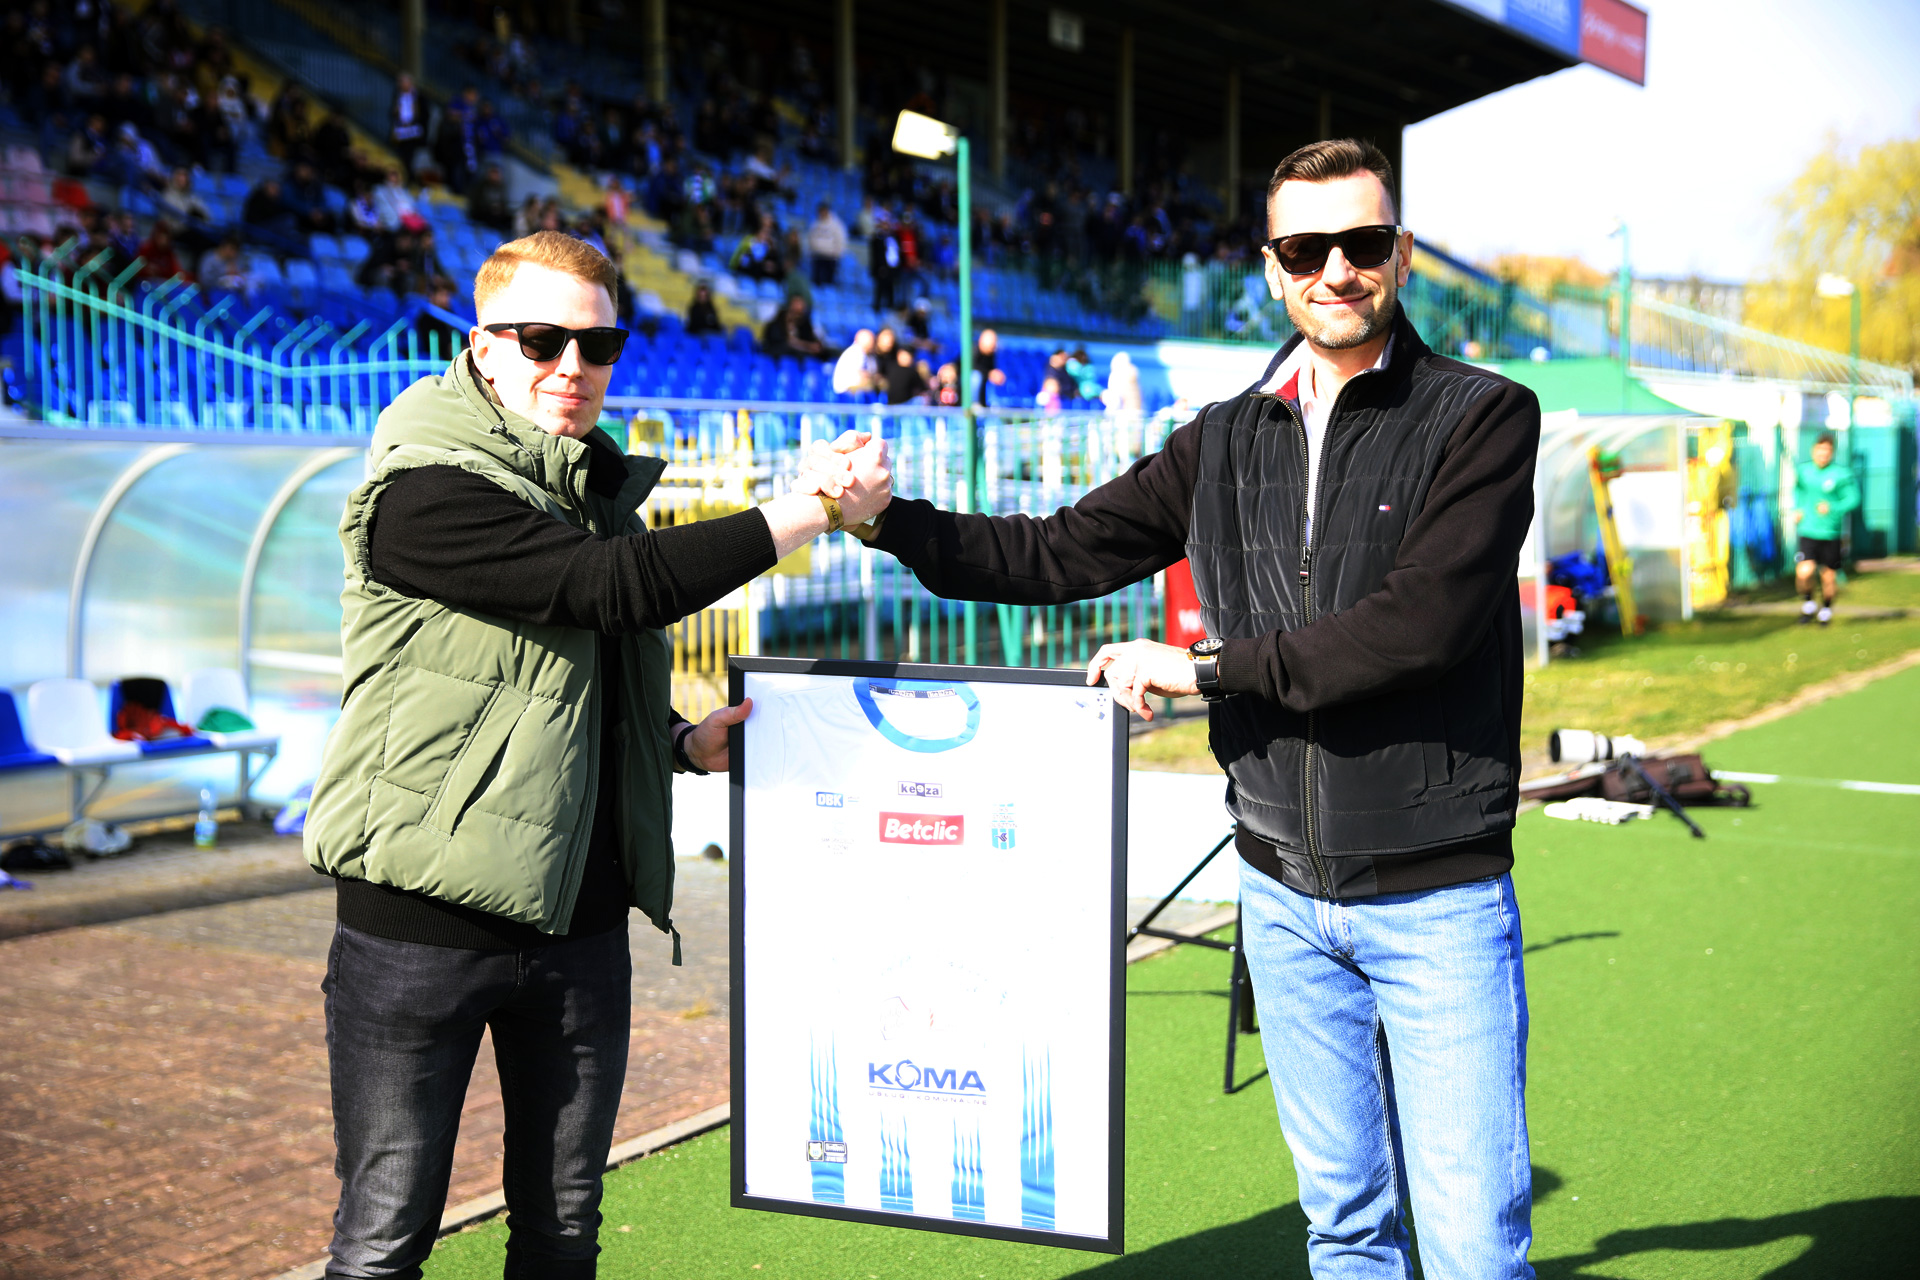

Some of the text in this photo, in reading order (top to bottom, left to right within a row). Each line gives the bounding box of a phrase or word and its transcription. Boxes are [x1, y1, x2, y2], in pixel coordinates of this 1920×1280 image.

[818, 793, 842, 807] DBK
[884, 818, 958, 841] Betclic
[868, 1059, 986, 1092] KOMA
